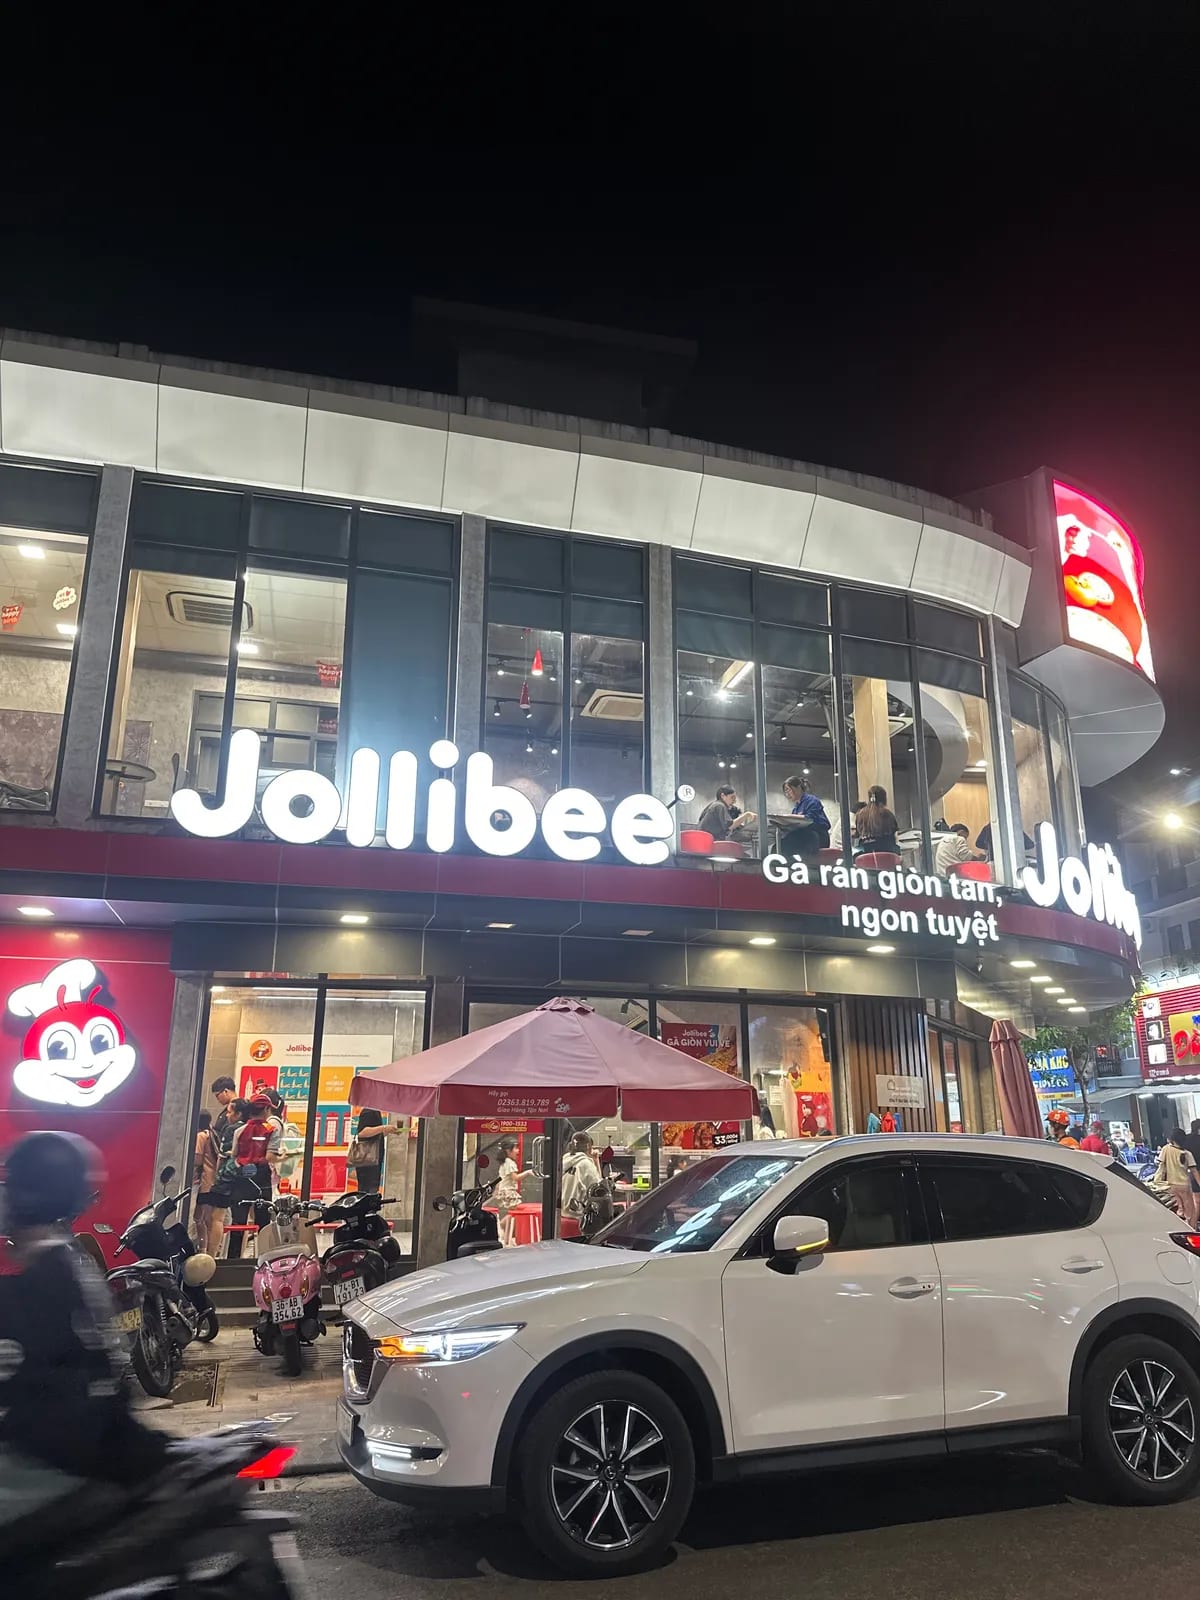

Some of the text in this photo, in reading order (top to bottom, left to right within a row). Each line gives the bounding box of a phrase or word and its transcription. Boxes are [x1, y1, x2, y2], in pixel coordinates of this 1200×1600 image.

[170, 728, 677, 866] Jollibee
[762, 853, 1003, 908] Gà rán giòn tan,
[841, 904, 1000, 946] ngon tuyệt
[703, 1039, 718, 1047] VUI
[497, 1098, 550, 1106] 02363.819.789
[275, 1297, 298, 1311] 36-AB
[273, 1307, 301, 1322] 354.62
